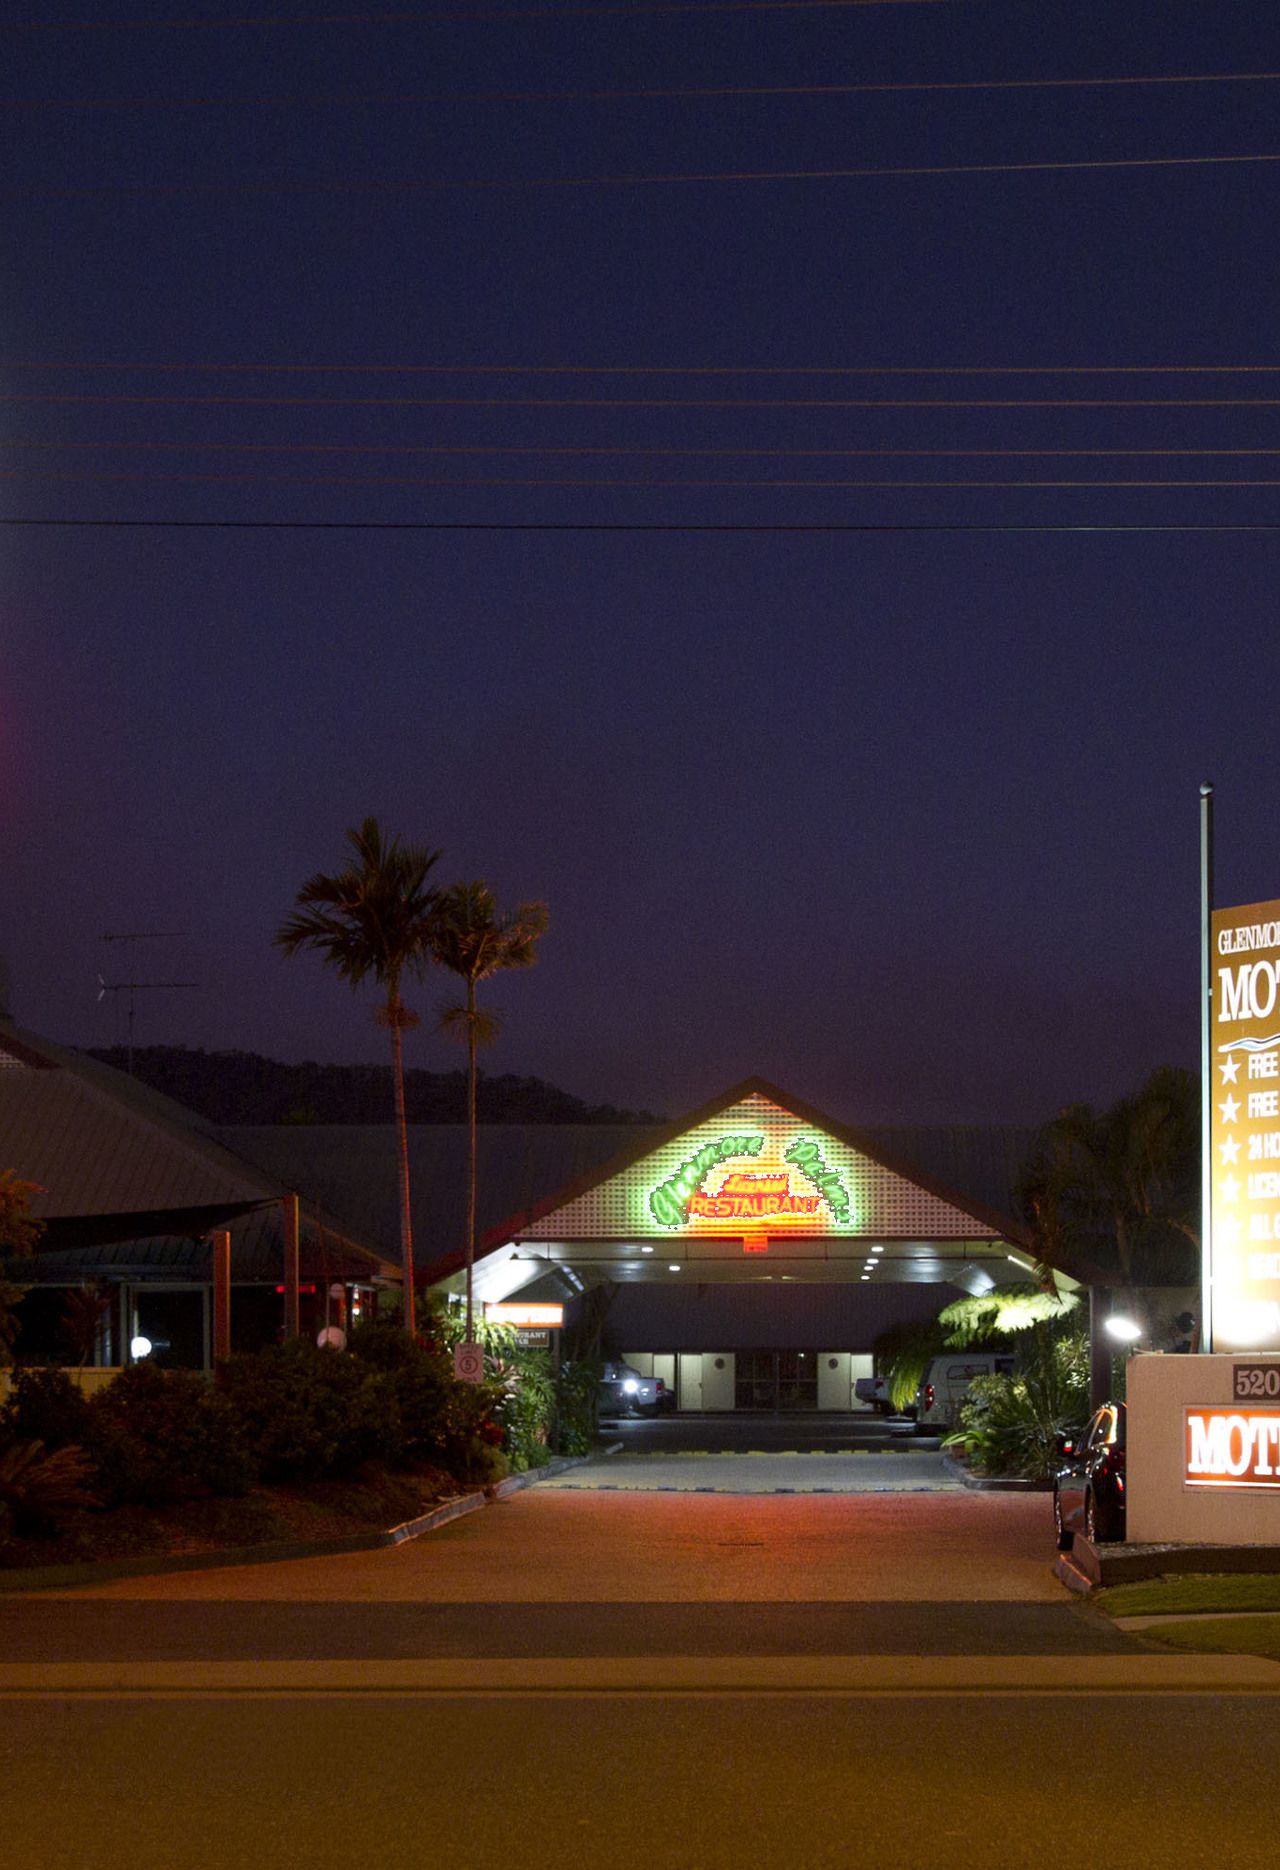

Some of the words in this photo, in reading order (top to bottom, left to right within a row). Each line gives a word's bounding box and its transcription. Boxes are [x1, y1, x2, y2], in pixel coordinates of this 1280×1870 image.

[1247, 1051, 1279, 1079] FREE
[1247, 1090, 1279, 1118] FREE
[690, 1196, 820, 1216] RESTAURANT
[1249, 1213, 1274, 1240] ALL
[464, 1359, 473, 1370] 5
[1236, 1370, 1280, 1395] 520
